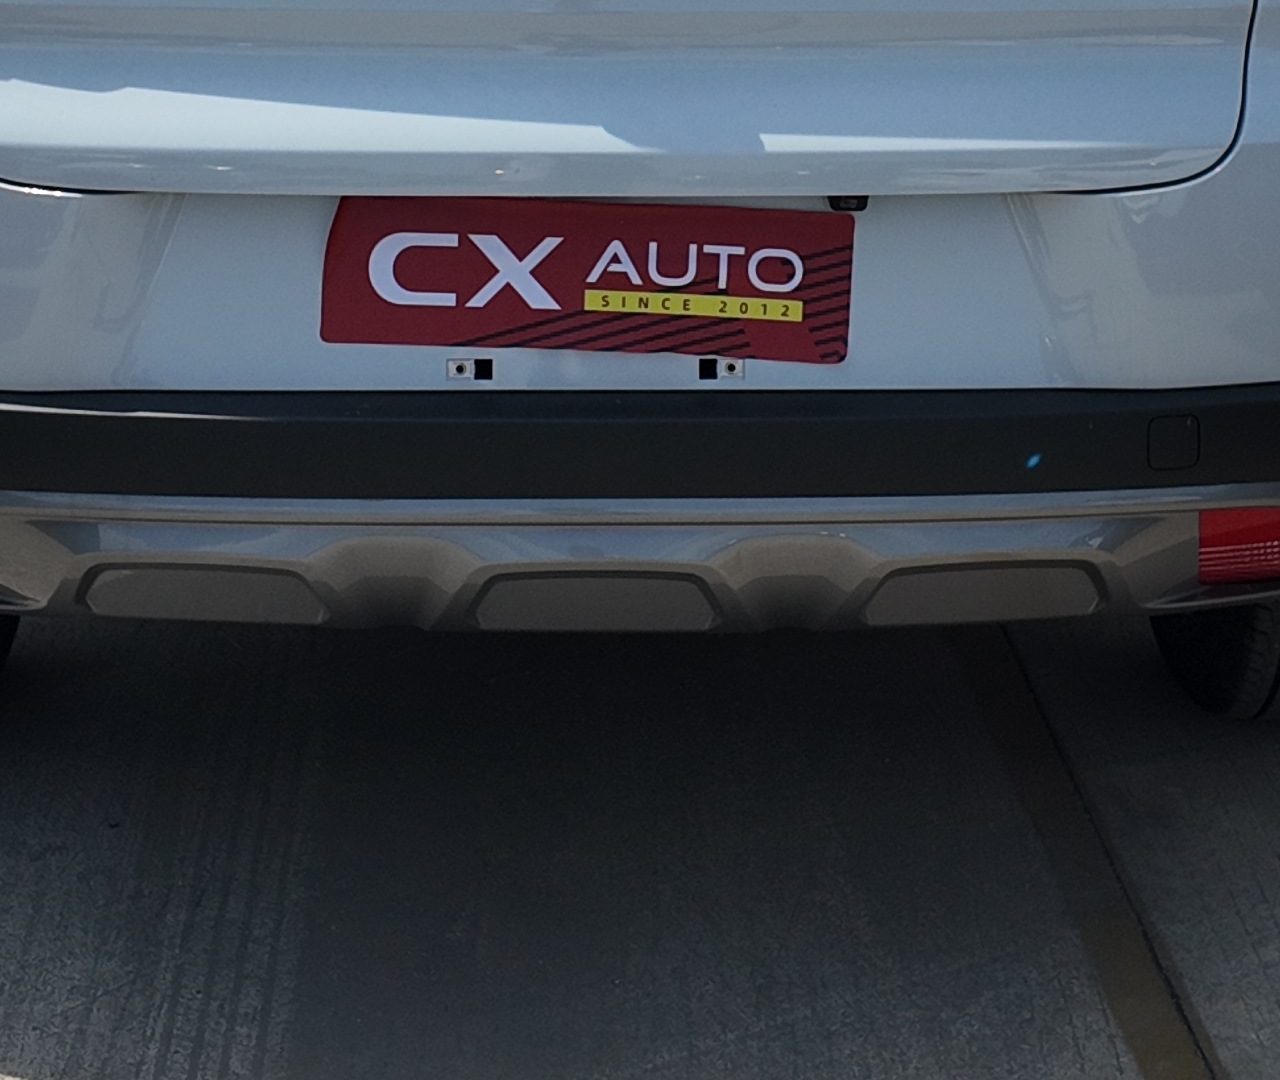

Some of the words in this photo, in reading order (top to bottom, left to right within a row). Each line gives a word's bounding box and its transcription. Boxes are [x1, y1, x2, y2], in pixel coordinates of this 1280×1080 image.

[368, 231, 565, 311] CX
[585, 239, 805, 293] AUTO
[600, 294, 692, 312] SINCE
[717, 300, 791, 318] 2012
